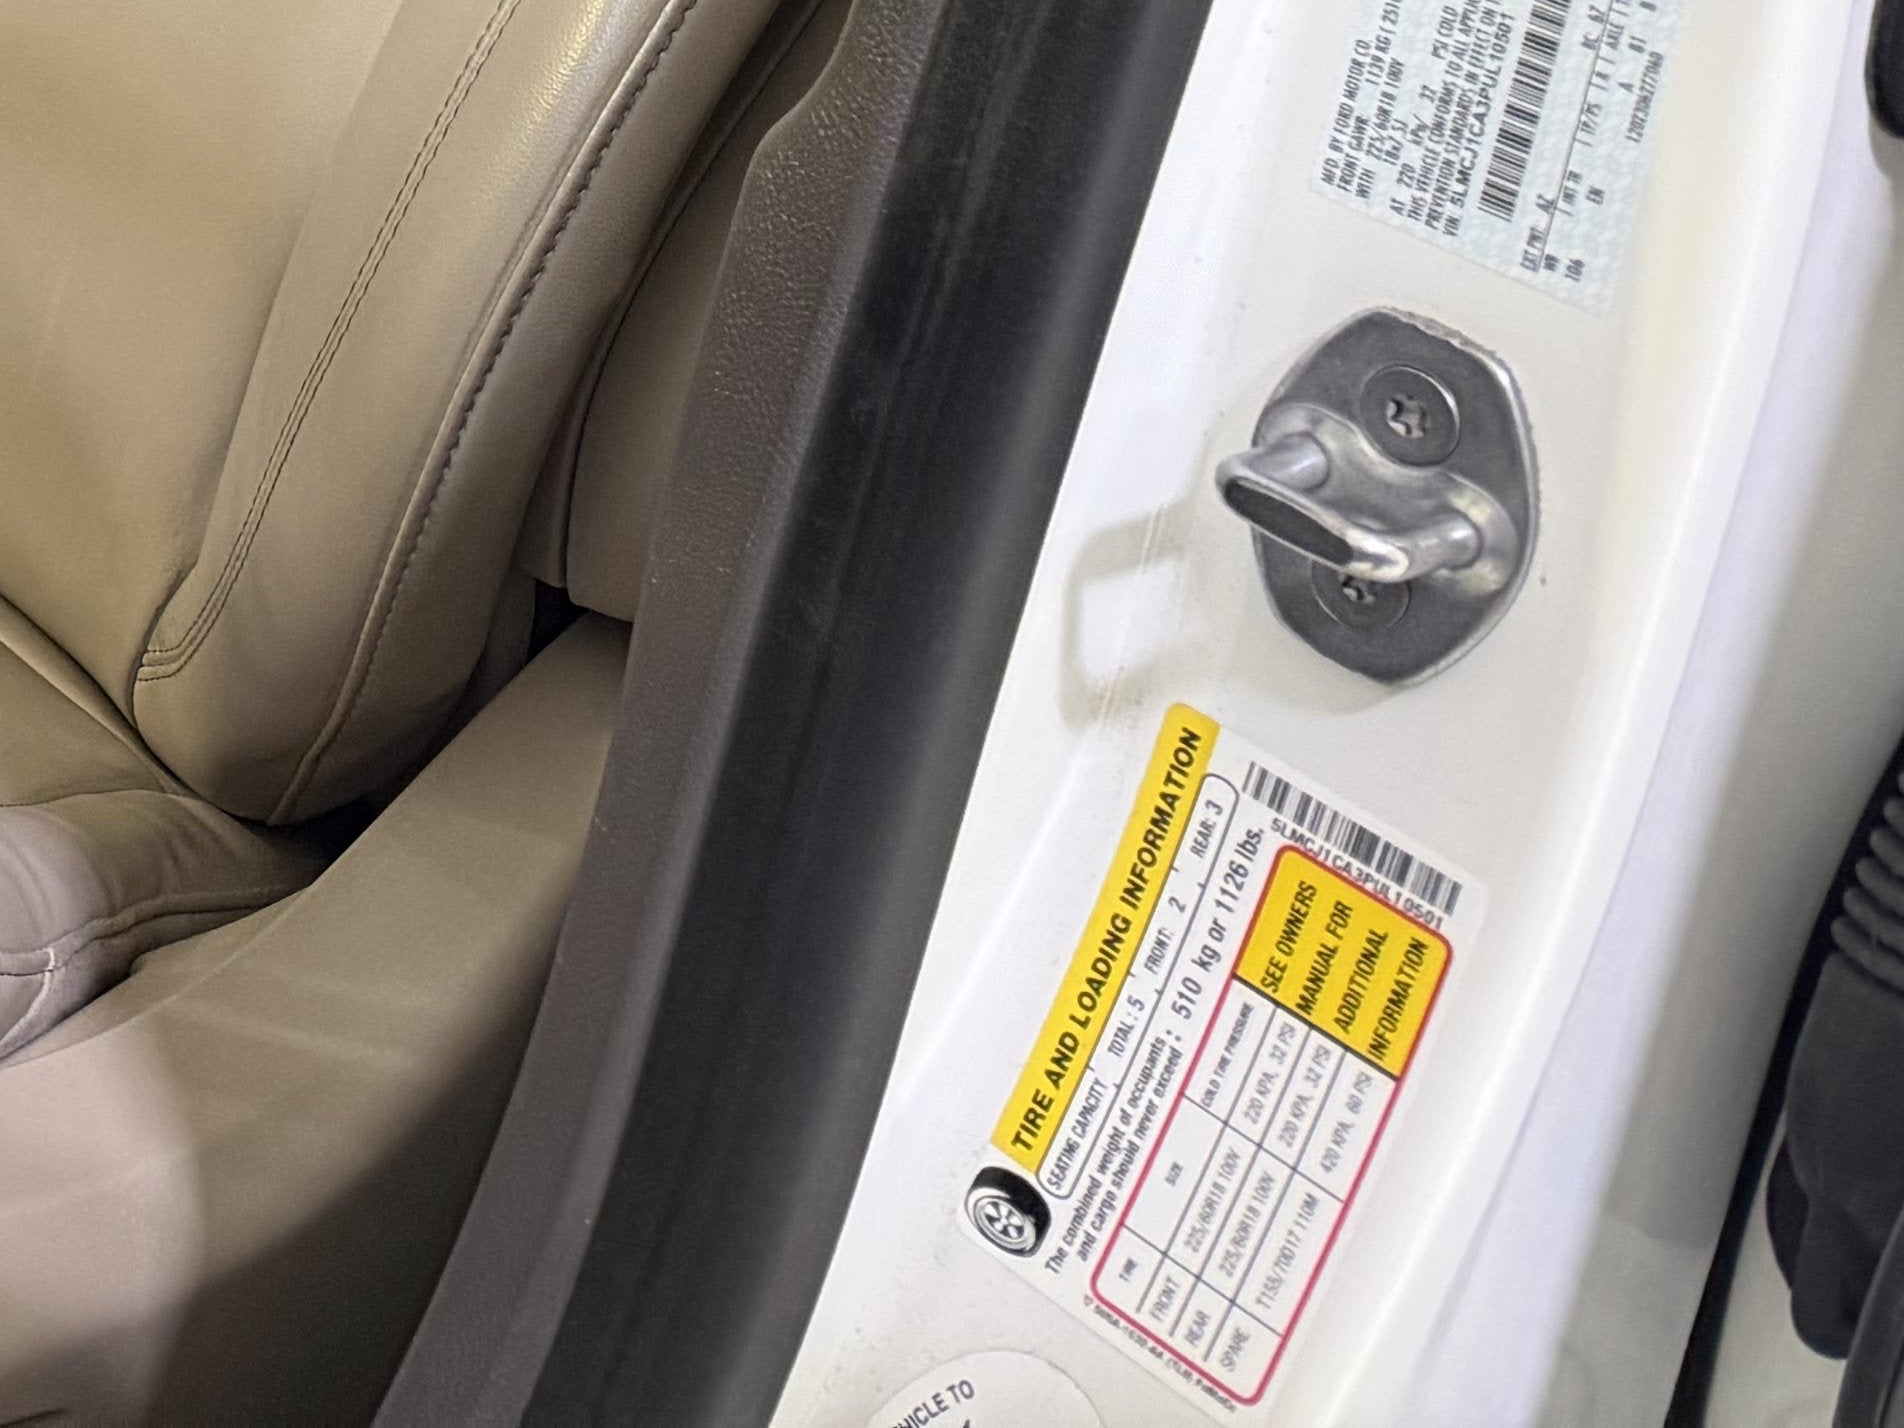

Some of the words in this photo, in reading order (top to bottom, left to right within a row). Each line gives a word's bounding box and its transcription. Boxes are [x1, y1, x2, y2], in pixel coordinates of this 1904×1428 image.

[1435, 4, 1458, 39] COLD
[1478, 5, 1498, 28] ON
[1373, 33, 1391, 53] KG
[1449, 36, 1469, 61] ALL
[1467, 27, 1493, 70] EFFECT
[1341, 56, 1366, 102] MOTOR
[1364, 53, 1386, 86] 1139
[1444, 59, 1463, 78] TO
[1462, 69, 1481, 85] IN
[1332, 100, 1354, 135] FORD
[1364, 90, 1397, 160] 225/60R18
[1426, 78, 1458, 145] CONFORMS
[1443, 85, 1476, 157] STANDARDS
[1449, 11, 1515, 209] 5LMCJ1CA3PUL10501
[1336, 152, 1359, 193] FRONT
[1354, 166, 1376, 201] WITH
[1395, 161, 1417, 189] 220
[1413, 145, 1440, 194] VEHICLE
[1387, 196, 1406, 216] AT
[1406, 193, 1427, 222] THIS
[1424, 156, 1457, 231] PREVENTION
[1233, 821, 1265, 862] lbs.
[1211, 857, 1251, 915] 1126
[1205, 916, 1229, 944] or
[1271, 878, 1320, 958] OWNERS
[1010, 1086, 1054, 1157] TIRE
[1041, 1027, 1081, 1091] AND
[1068, 910, 1133, 1030] LOADING
[1118, 725, 1202, 910] INFORMATION
[1190, 940, 1222, 975] kg
[1293, 938, 1340, 1016] MANUAL
[1323, 899, 1354, 940] FOR
[1259, 954, 1288, 994] SEE
[1329, 923, 1391, 1035] ADDITIONAL
[1045, 1133, 1080, 1192] SEATING
[1069, 1074, 1108, 1141] CAPACITY
[1126, 993, 1146, 1012] 5
[1166, 894, 1188, 914] 2
[1203, 798, 1224, 816] 3
[1169, 973, 1203, 1021] 510
[1363, 936, 1432, 1061] INFORMATION
[1275, 1020, 1298, 1047] PSI
[1267, 1042, 1288, 1066] 32
[1310, 1042, 1333, 1069] PSI
[1302, 1065, 1323, 1089] 32
[1352, 1068, 1375, 1096] PSI
[1242, 1094, 1266, 1125] 220
[1343, 1091, 1365, 1115] 60
[1277, 1117, 1300, 1148] 220
[1043, 1241, 1069, 1278] The
[1059, 1172, 1102, 1249] combined
[1093, 1124, 1128, 1180] weight
[1115, 1106, 1133, 1127] of
[1125, 1033, 1169, 1112] occupants
[1073, 1228, 1097, 1263] and
[1089, 1186, 1120, 1236] cargo
[1108, 1137, 1140, 1192] should
[1131, 1096, 1159, 1141] never
[1149, 1044, 1183, 1100] exceed
[1215, 1144, 1242, 1184] 100V
[1317, 1144, 1342, 1176] 420
[1250, 1167, 1277, 1207] 100V
[1183, 1177, 1227, 1256] 225/60R18
[1292, 1189, 1320, 1231] 110M
[1217, 1201, 1262, 1280] 225/60R18
[1255, 1227, 1304, 1314] T155/70D17
[1149, 1273, 1181, 1324] FRONT
[1183, 1307, 1211, 1349] REAR
[1218, 1323, 1251, 1374] SPARE
[946, 1379, 975, 1404] TO
